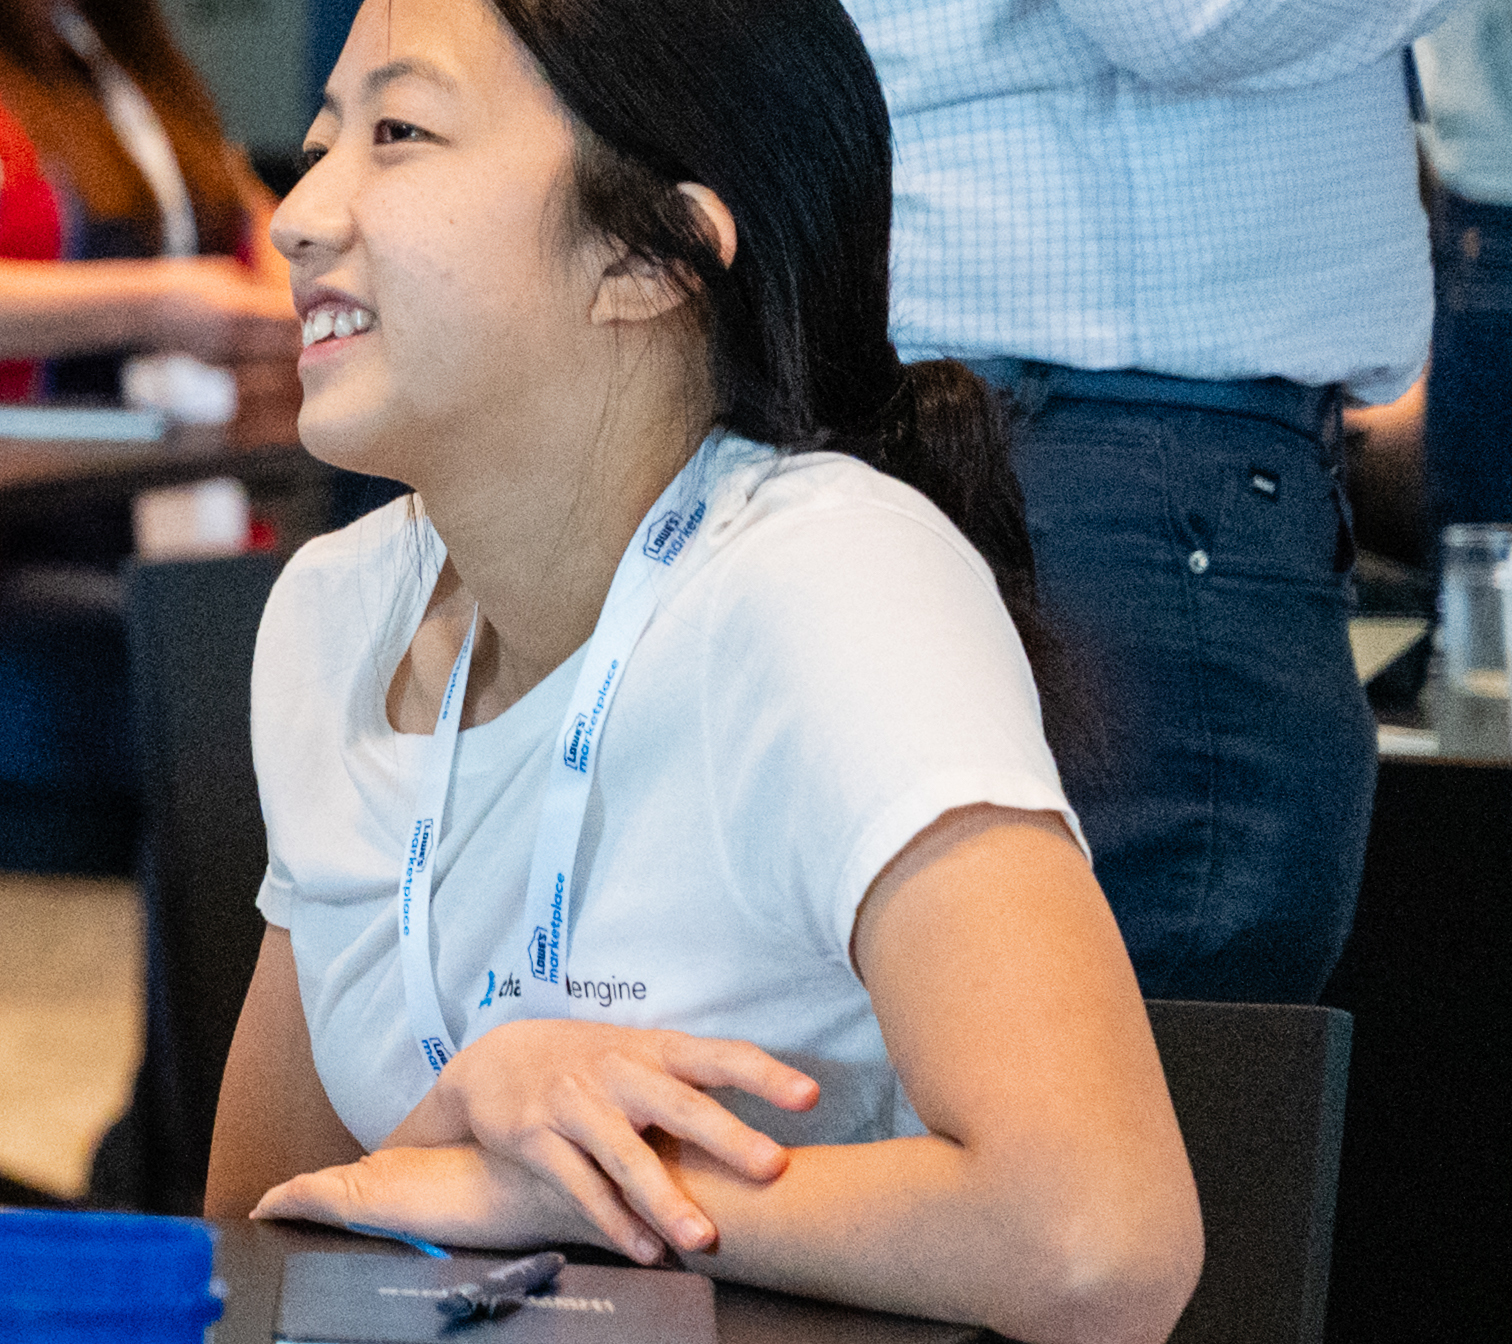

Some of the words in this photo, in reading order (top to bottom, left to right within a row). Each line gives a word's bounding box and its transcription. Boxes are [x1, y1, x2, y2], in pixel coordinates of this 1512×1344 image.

[579, 659, 619, 774] marketplace
[403, 820, 422, 936] marketplace
[548, 872, 565, 984] marketplace
